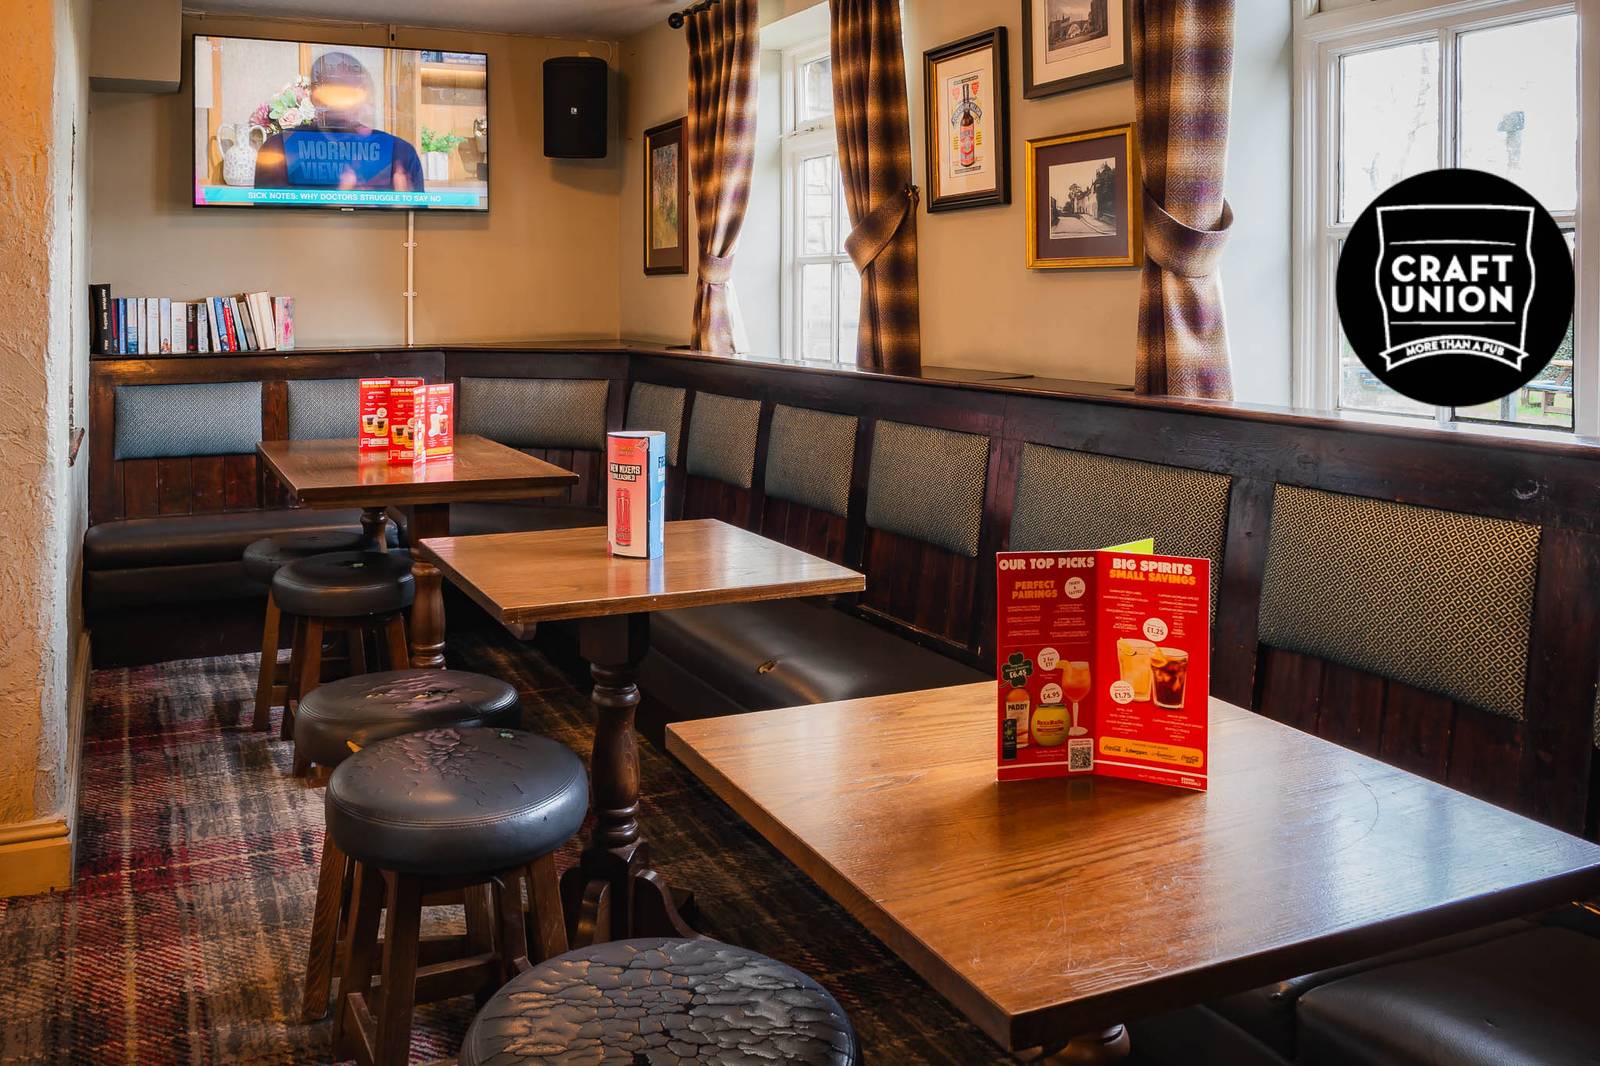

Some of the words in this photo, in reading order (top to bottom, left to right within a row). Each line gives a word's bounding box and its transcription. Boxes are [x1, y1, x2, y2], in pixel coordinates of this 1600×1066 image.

[298, 140, 381, 161] MORNING
[269, 192, 298, 200] NOTES:
[300, 192, 319, 200] WHY
[320, 193, 358, 201] DOCTORS
[999, 559, 1026, 571] OUR
[1030, 558, 1055, 570] TOP
[1058, 557, 1095, 569] PICKS
[1112, 558, 1136, 571] BIG
[1140, 560, 1192, 576] SPIRITS
[1109, 569, 1146, 581] SMALL
[1148, 573, 1197, 585] SAVINGS
[1015, 580, 1055, 590] PERFECT
[1012, 590, 1058, 599] PAIRINGS
[1147, 626, 1164, 635] £1.25
[1043, 691, 1060, 700] £4.95
[1008, 703, 1028, 711] PADDY
